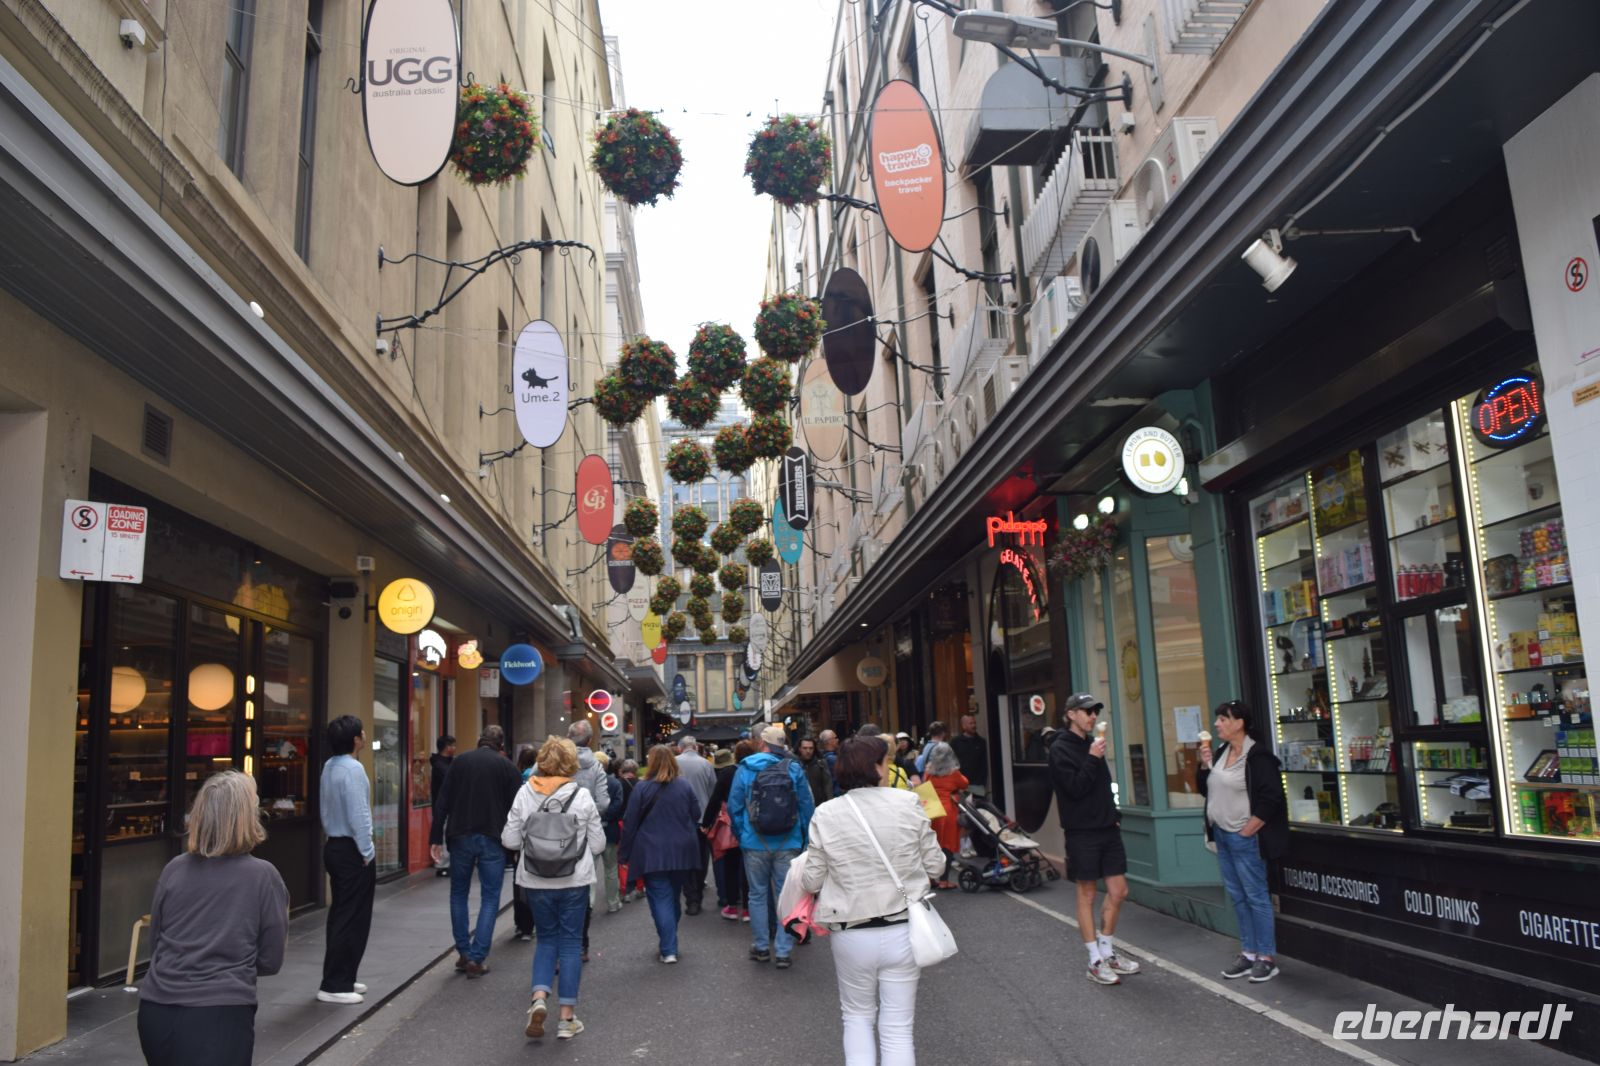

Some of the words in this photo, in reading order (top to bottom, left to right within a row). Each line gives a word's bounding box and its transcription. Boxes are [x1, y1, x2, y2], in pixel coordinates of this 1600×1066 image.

[368, 56, 453, 86] UGG
[372, 88, 411, 98] australia
[414, 87, 446, 96] classic
[880, 150, 917, 164] happy
[887, 157, 929, 171] travels
[521, 391, 560, 403] Ume.2
[1479, 382, 1540, 434] OPEN
[1125, 434, 1142, 457] LEMON
[1160, 432, 1182, 458] BUTTER
[109, 509, 144, 521] LOADING
[111, 518, 142, 531] ZONE
[504, 660, 537, 669] Fieldwork
[1283, 867, 1319, 892] TOBACCO
[1321, 874, 1380, 905] ACCESSORIES
[1404, 889, 1433, 916] COLD
[1436, 895, 1480, 926] DRINKS
[1519, 909, 1600, 950] CIGARETTE
